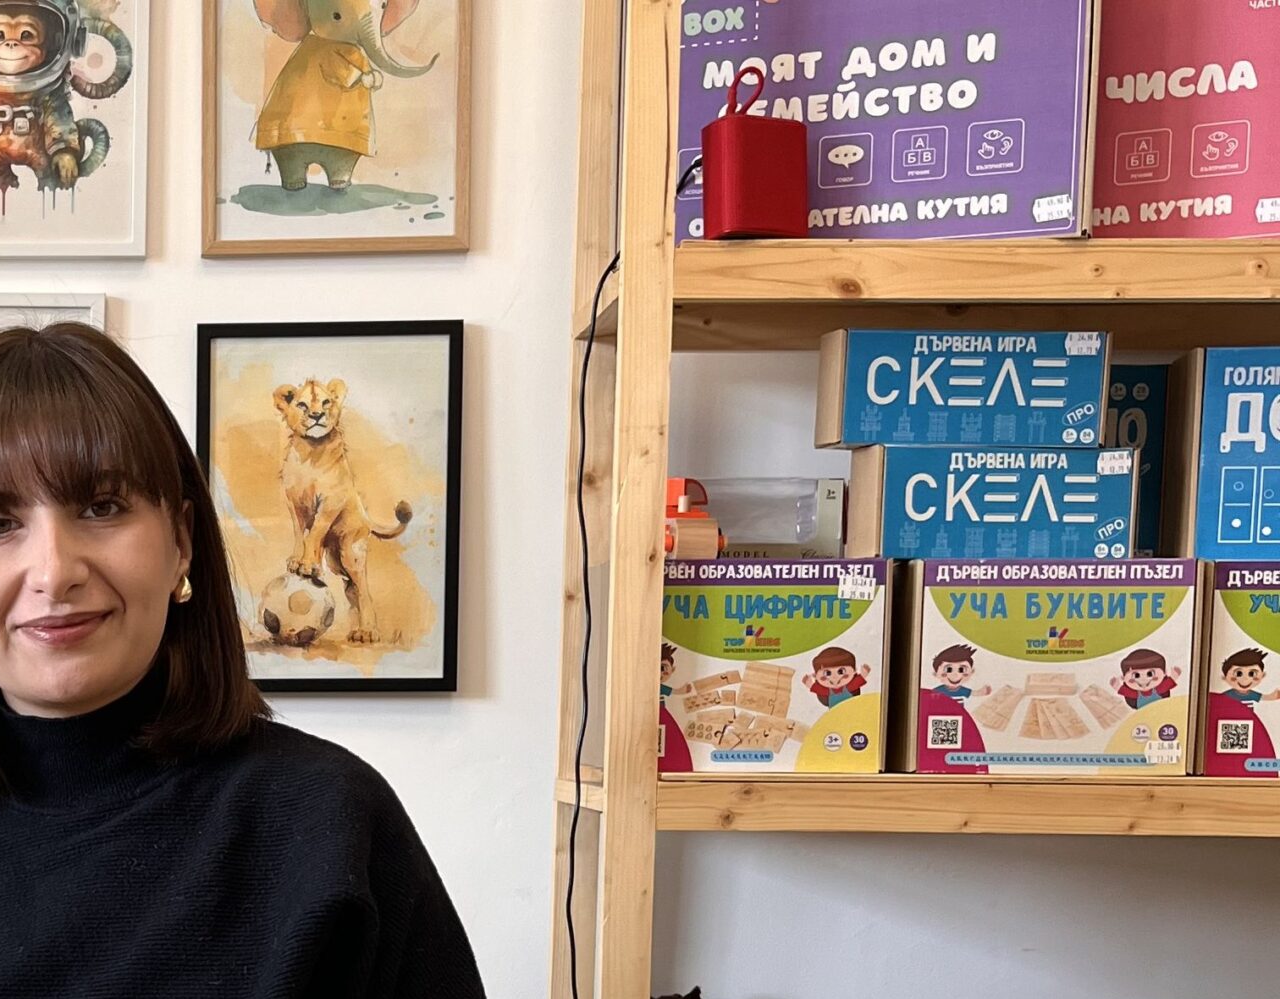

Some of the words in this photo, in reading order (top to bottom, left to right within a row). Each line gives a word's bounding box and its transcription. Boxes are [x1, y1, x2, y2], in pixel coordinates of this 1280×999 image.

[683, 7, 745, 36] BOX
[703, 51, 822, 89] МОЯТ
[841, 37, 946, 80] ДОМ
[966, 33, 996, 65] И
[1105, 60, 1258, 104] ЧИСЛА
[917, 193, 1008, 221] КУТИЯ
[1140, 195, 1232, 222] КУТИЯ
[914, 336, 992, 355] ДЪРВЕНА
[997, 336, 1037, 353] ИГРА
[866, 356, 1069, 407] СКЕЛЕ
[1066, 403, 1095, 425] ПРО
[949, 453, 1025, 471] ДЪРВЕНА
[1030, 453, 1067, 470] ИГРА
[904, 473, 1100, 523] СКЕЛЕ
[1098, 518, 1125, 540] ПРО
[699, 564, 819, 579] ОБРАЗОВАТЕЛЕН
[823, 564, 874, 579] ПЪЗЕЛ
[936, 564, 999, 582] ДЪРВЕН
[1002, 564, 1127, 581] ОБРАЗОВАТЕЛЕН
[1130, 563, 1183, 580] ПЪЗЕЛ
[724, 594, 852, 624] ЦИФРИТЕ
[949, 592, 1008, 619] УЧА
[1025, 592, 1166, 619] БУКВИТЕ
[827, 735, 840, 744] 3+
[853, 734, 865, 743] 30
[1135, 727, 1147, 735] 3+
[1162, 726, 1174, 735] 30
